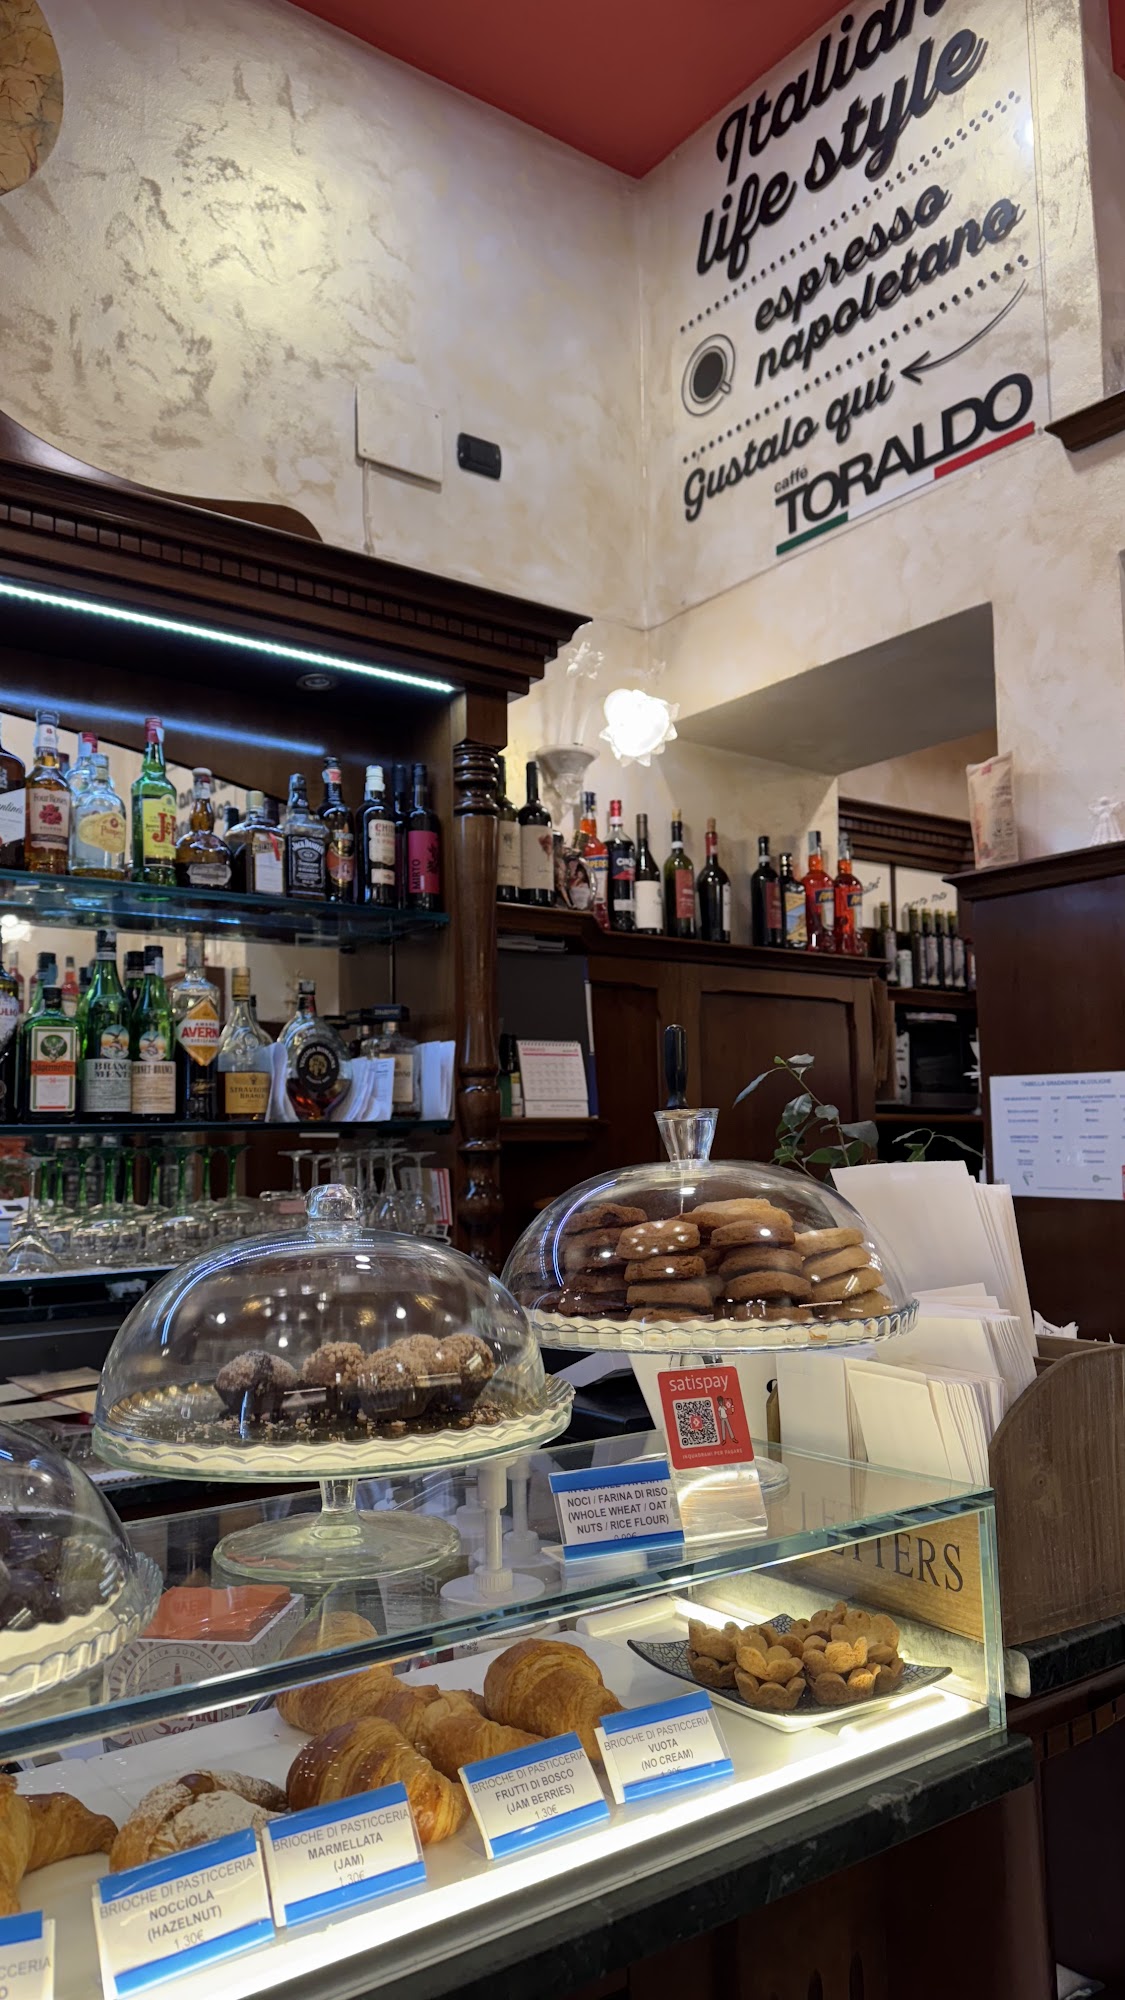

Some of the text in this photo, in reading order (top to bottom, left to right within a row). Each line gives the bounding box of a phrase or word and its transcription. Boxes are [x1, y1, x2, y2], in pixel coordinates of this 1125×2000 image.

[697, 28, 988, 279] life style
[754, 183, 952, 332] espresso
[754, 197, 1027, 387] napoletano
[684, 359, 895, 522] Gustalo qui
[774, 372, 1034, 534] TORALDO
[412, 859, 421, 890] MIRTO
[669, 1375, 729, 1394] satispay
[567, 1496, 591, 1508] NOCI
[598, 1490, 633, 1504] FARINA
[635, 1490, 644, 1499] DI
[647, 1487, 668, 1497] RISO
[568, 1508, 607, 1523] (WHOLE
[608, 1503, 641, 1516] WHEAT
[649, 1501, 668, 1511] OAT
[577, 1523, 603, 1534] NUTS
[610, 1518, 632, 1530] RICE
[634, 1514, 669, 1527] FLOUR)
[176, 1648, 201, 1660] SODA
[604, 1716, 711, 1751] BRIOCHE DI PASTICCERIA
[648, 1738, 679, 1752] VUOTA
[472, 1751, 586, 1794] BRIOCHE DI PASTICCERIA
[641, 1749, 694, 1771] (NO CREAM)
[495, 1769, 574, 1801] FRUTTI DI BOSCO
[506, 1784, 575, 1815] (JAM BERRIES)
[273, 1809, 410, 1852] BRIOCHE DI PASTICCERIA
[308, 1832, 383, 1860] MARMELLATA
[333, 1854, 365, 1873] (JAM)
[100, 1857, 255, 1919] BRIOCHE DI PASTICCERIA
[150, 1889, 214, 1921] NOCCIOLA
[148, 1905, 222, 1943] (HAZELNUT)
